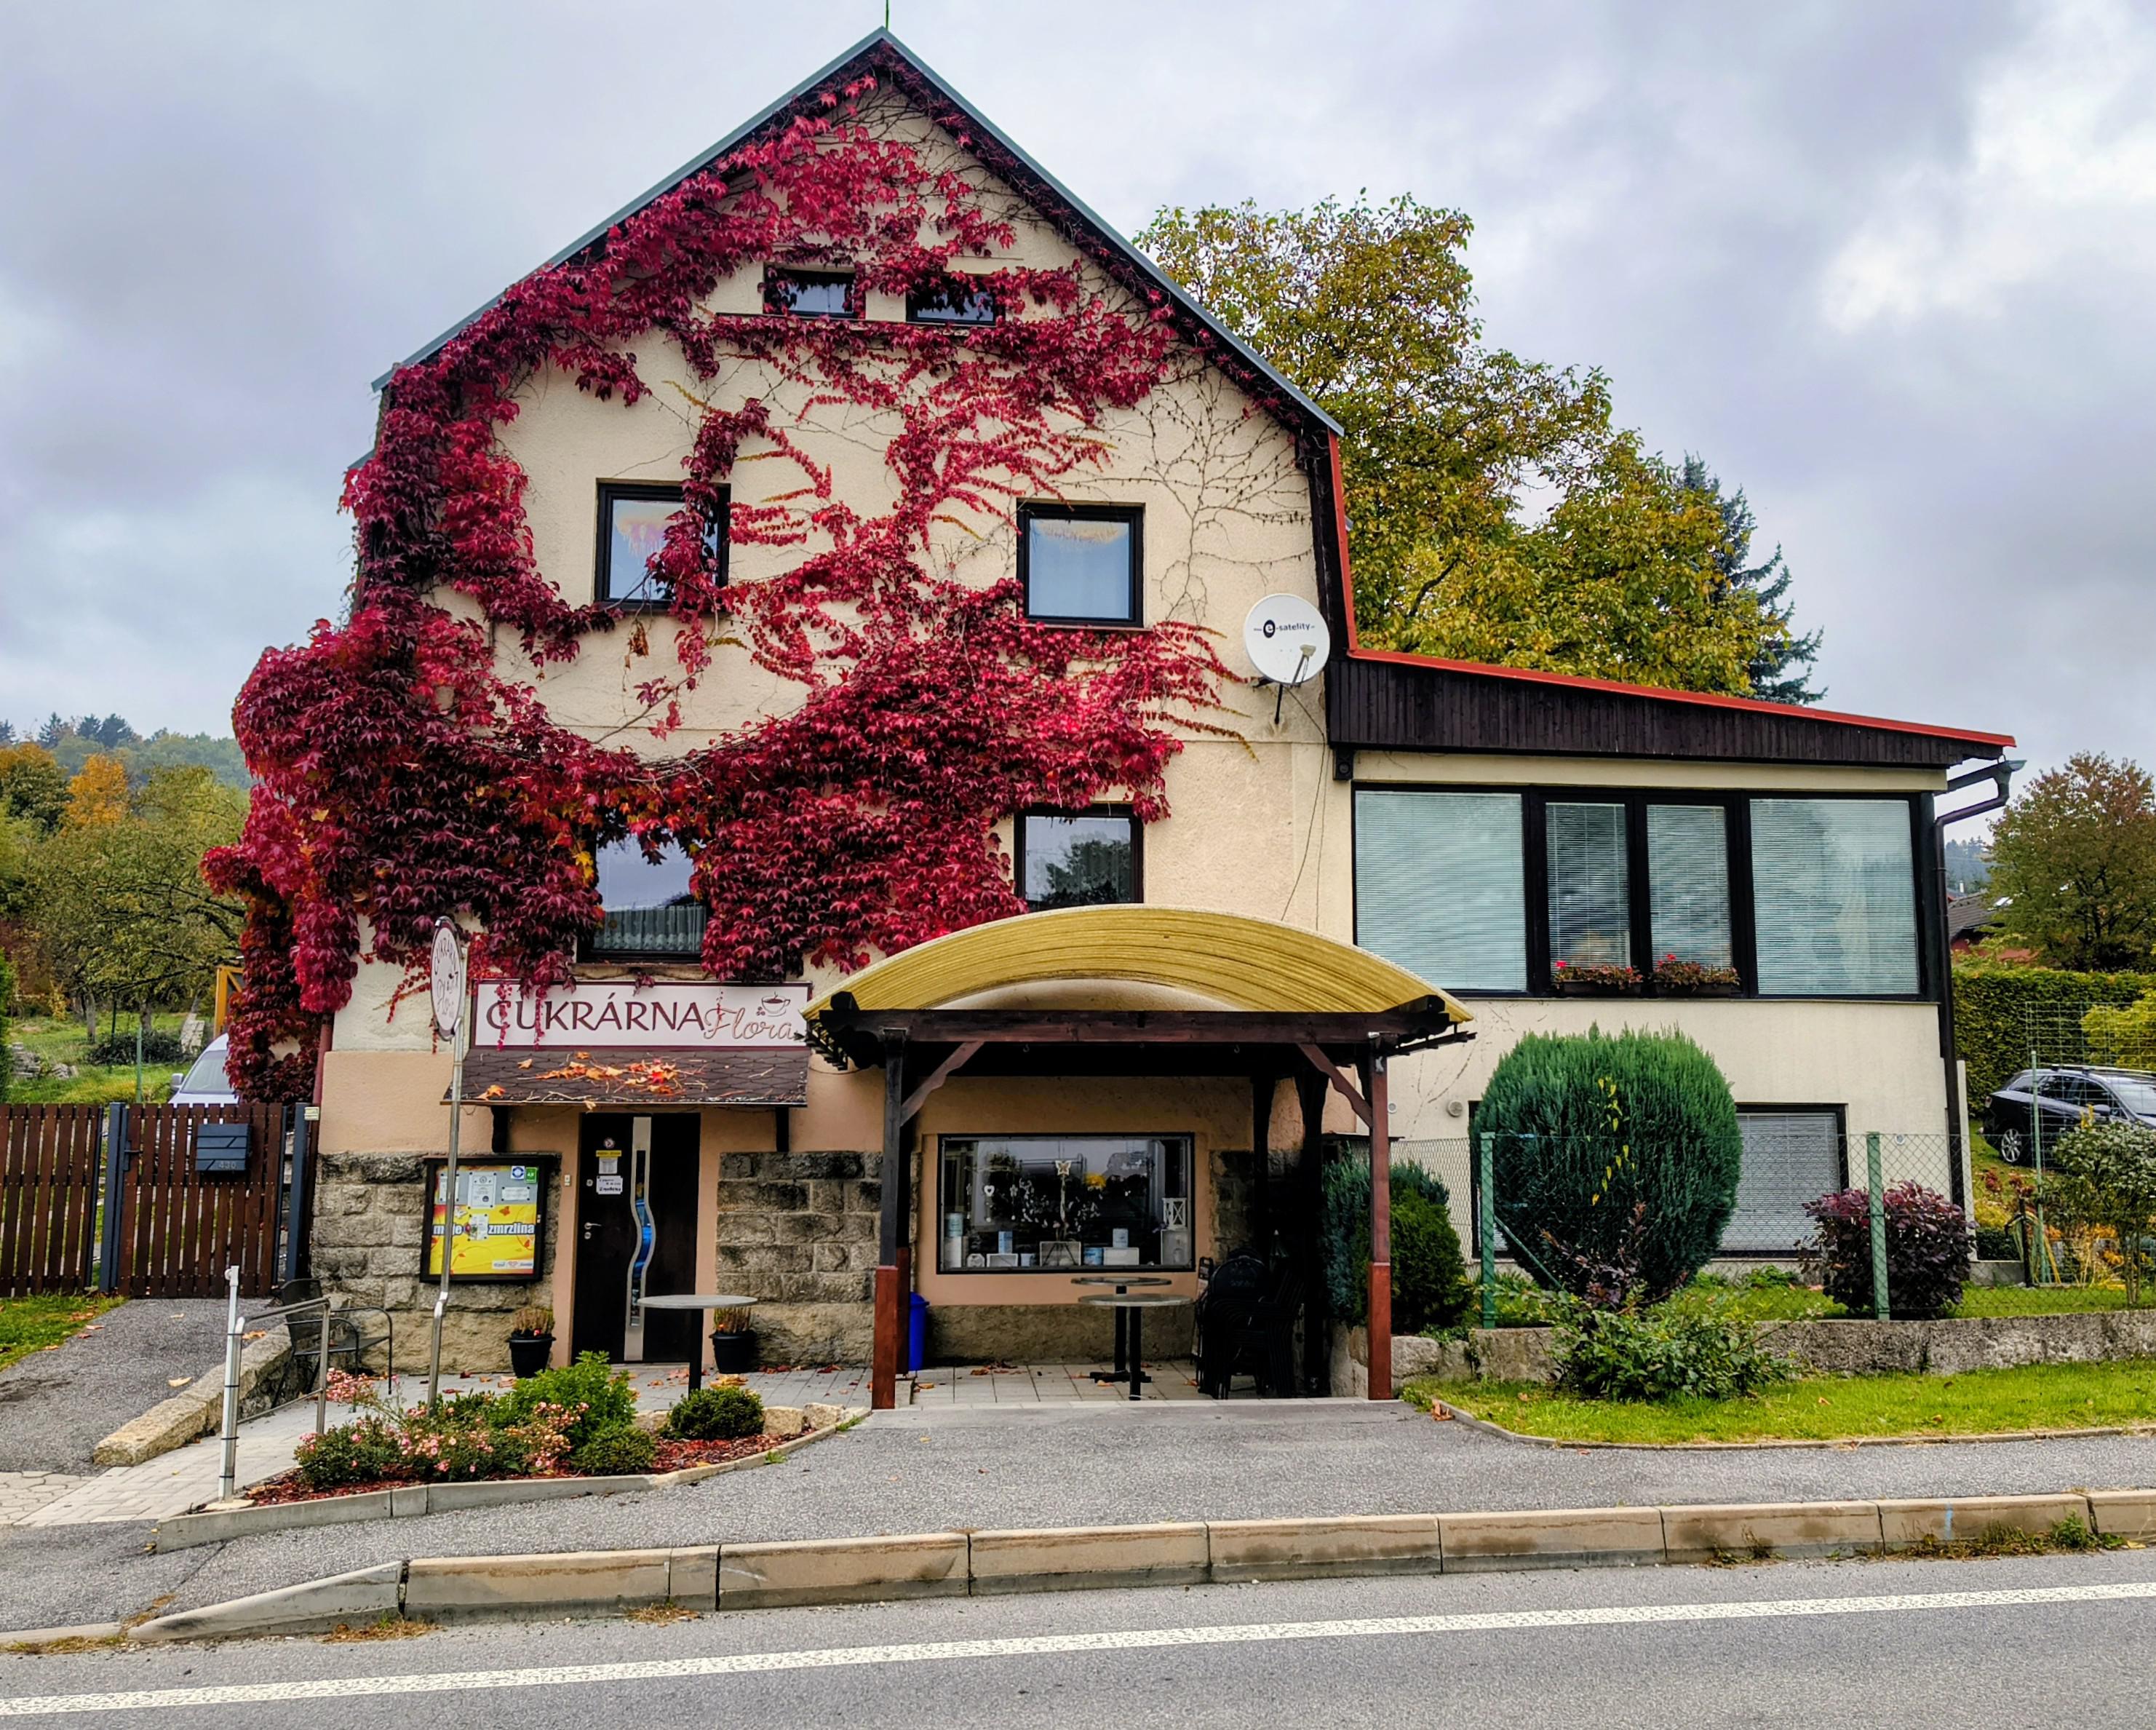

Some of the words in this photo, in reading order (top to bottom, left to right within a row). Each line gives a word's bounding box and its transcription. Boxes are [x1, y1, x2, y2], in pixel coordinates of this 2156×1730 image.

[486, 992, 704, 1031] CUKRÁRNA
[704, 1007, 795, 1039] Flora
[488, 1223, 534, 1234] zmrzlina
